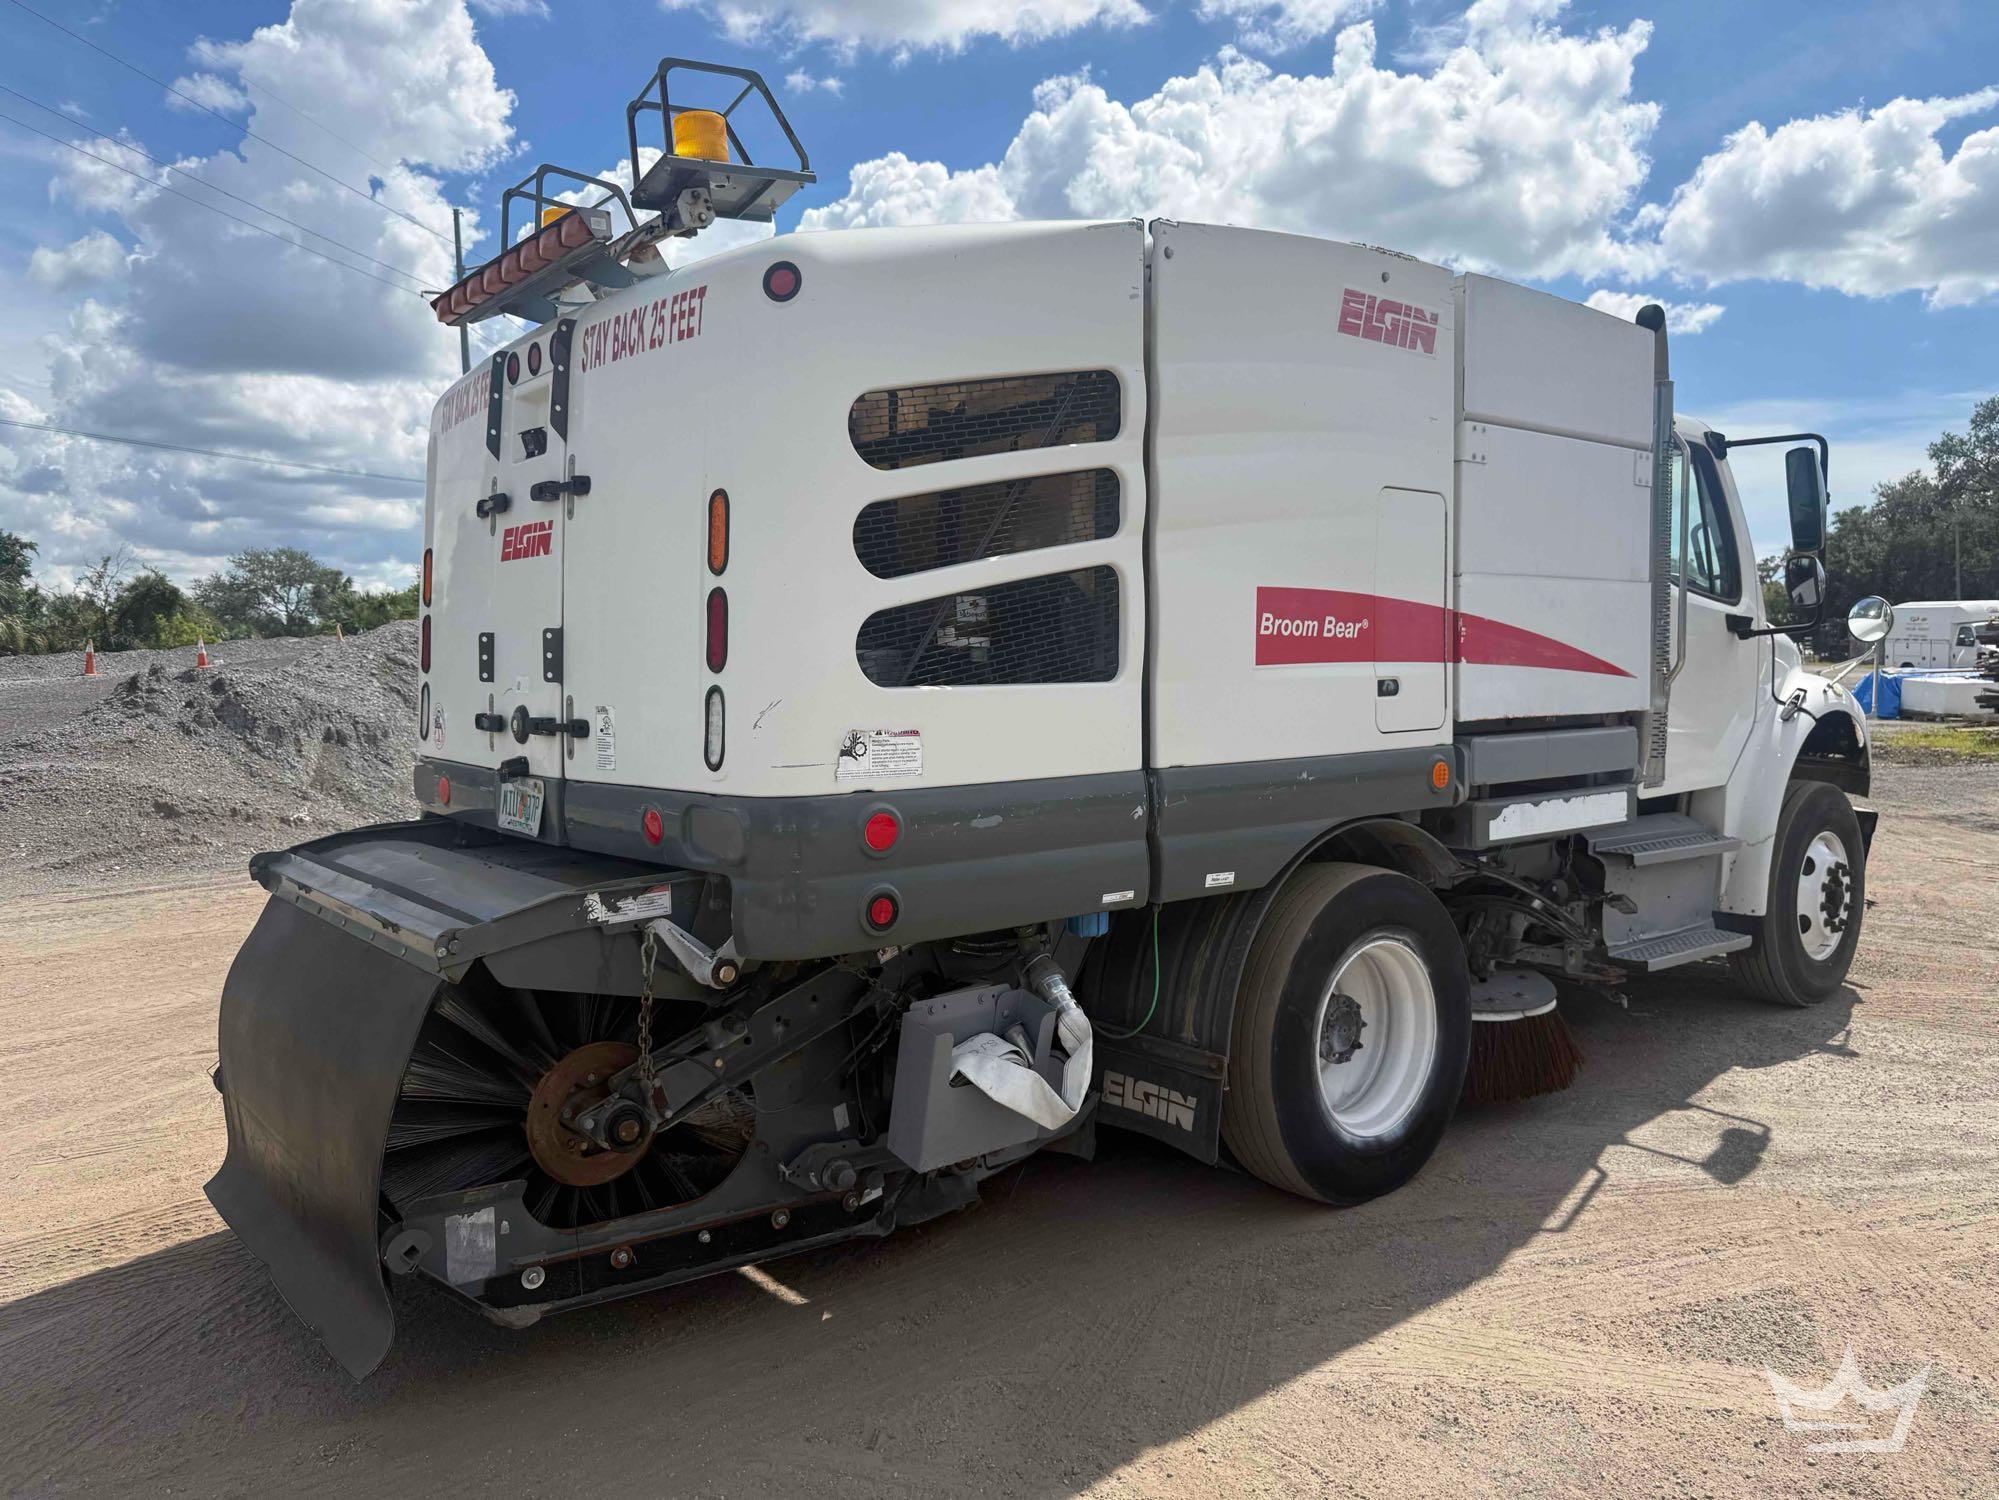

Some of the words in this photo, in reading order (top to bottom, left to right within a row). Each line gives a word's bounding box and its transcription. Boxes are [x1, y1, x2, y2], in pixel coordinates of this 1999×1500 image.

[581, 318, 611, 373] STAY
[611, 305, 648, 362] BACK
[649, 298, 668, 350] 25
[669, 285, 708, 344] FEET
[1337, 287, 1439, 355] ELGIN
[501, 519, 554, 563] ELGIN
[1260, 612, 1318, 637] Broom
[1101, 1069, 1198, 1132] ELGIN
